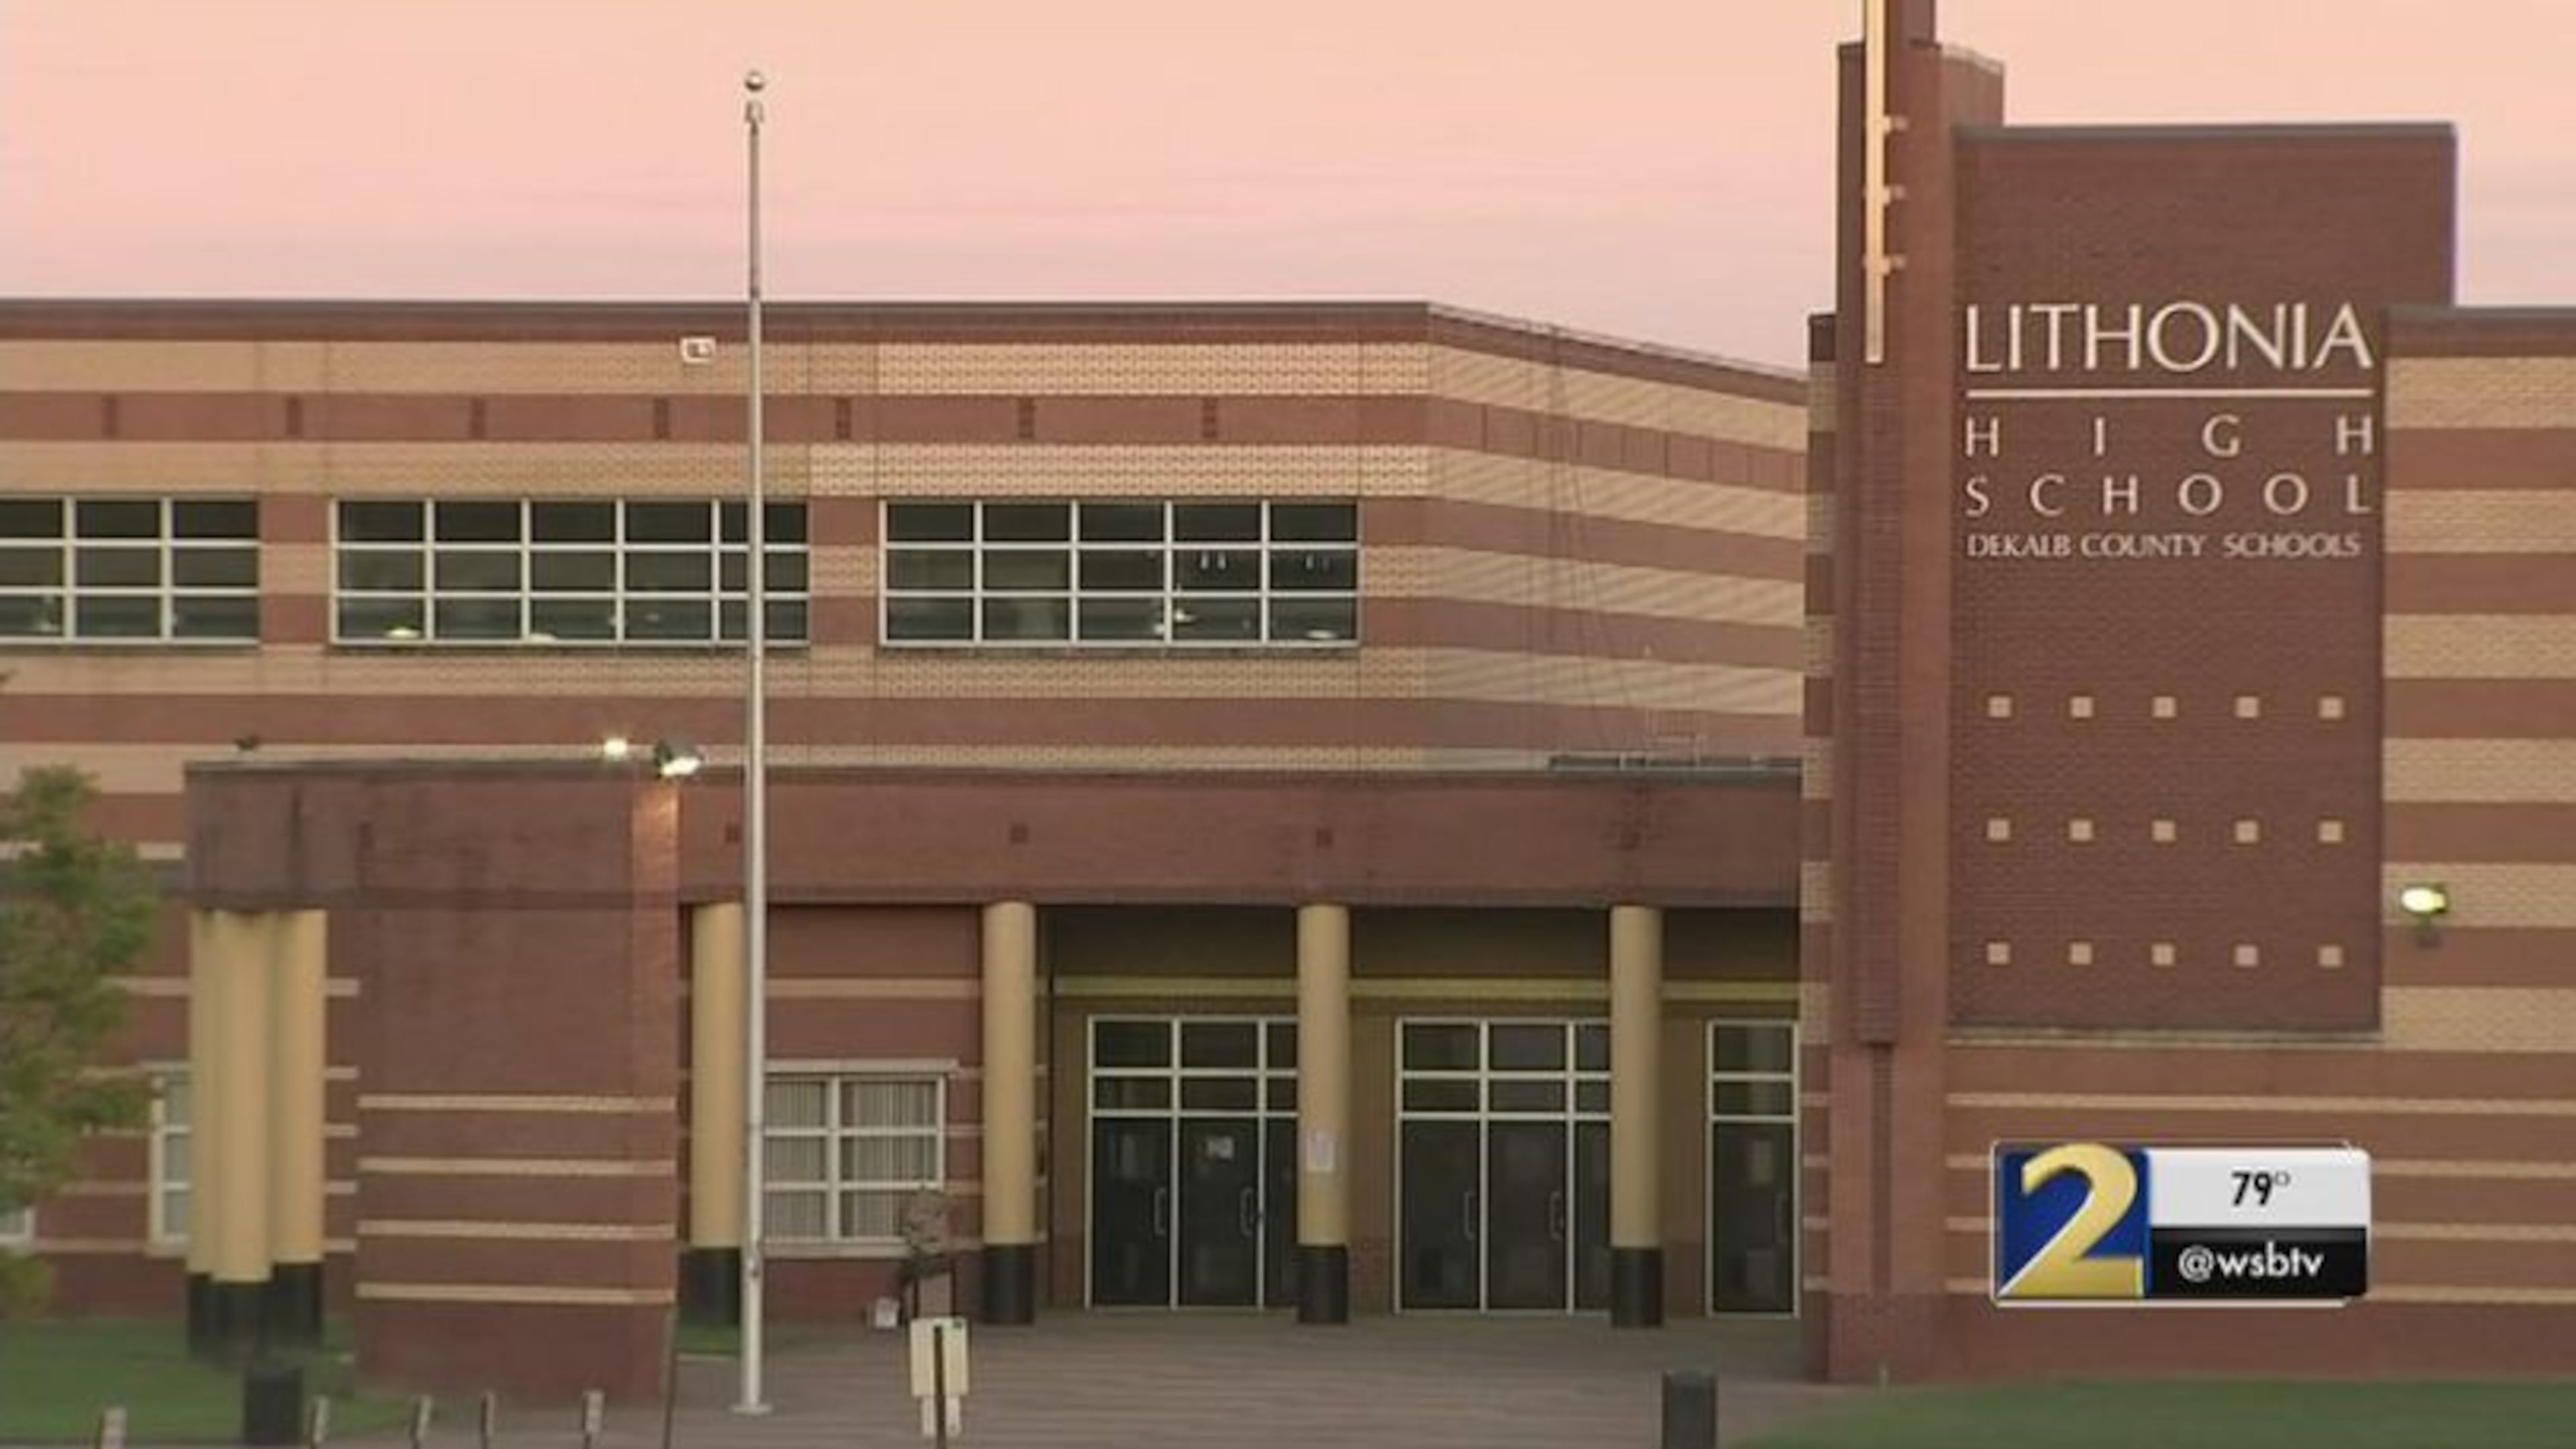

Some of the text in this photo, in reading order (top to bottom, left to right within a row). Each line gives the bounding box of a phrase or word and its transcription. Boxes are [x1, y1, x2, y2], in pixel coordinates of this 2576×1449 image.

[1966, 301, 2374, 372] LITHONIA
[1965, 414, 2373, 458] HIGH
[1965, 473, 2372, 517] SCHOOL
[1967, 531, 2361, 557] DEKALB COUNTY SCHOOLS
